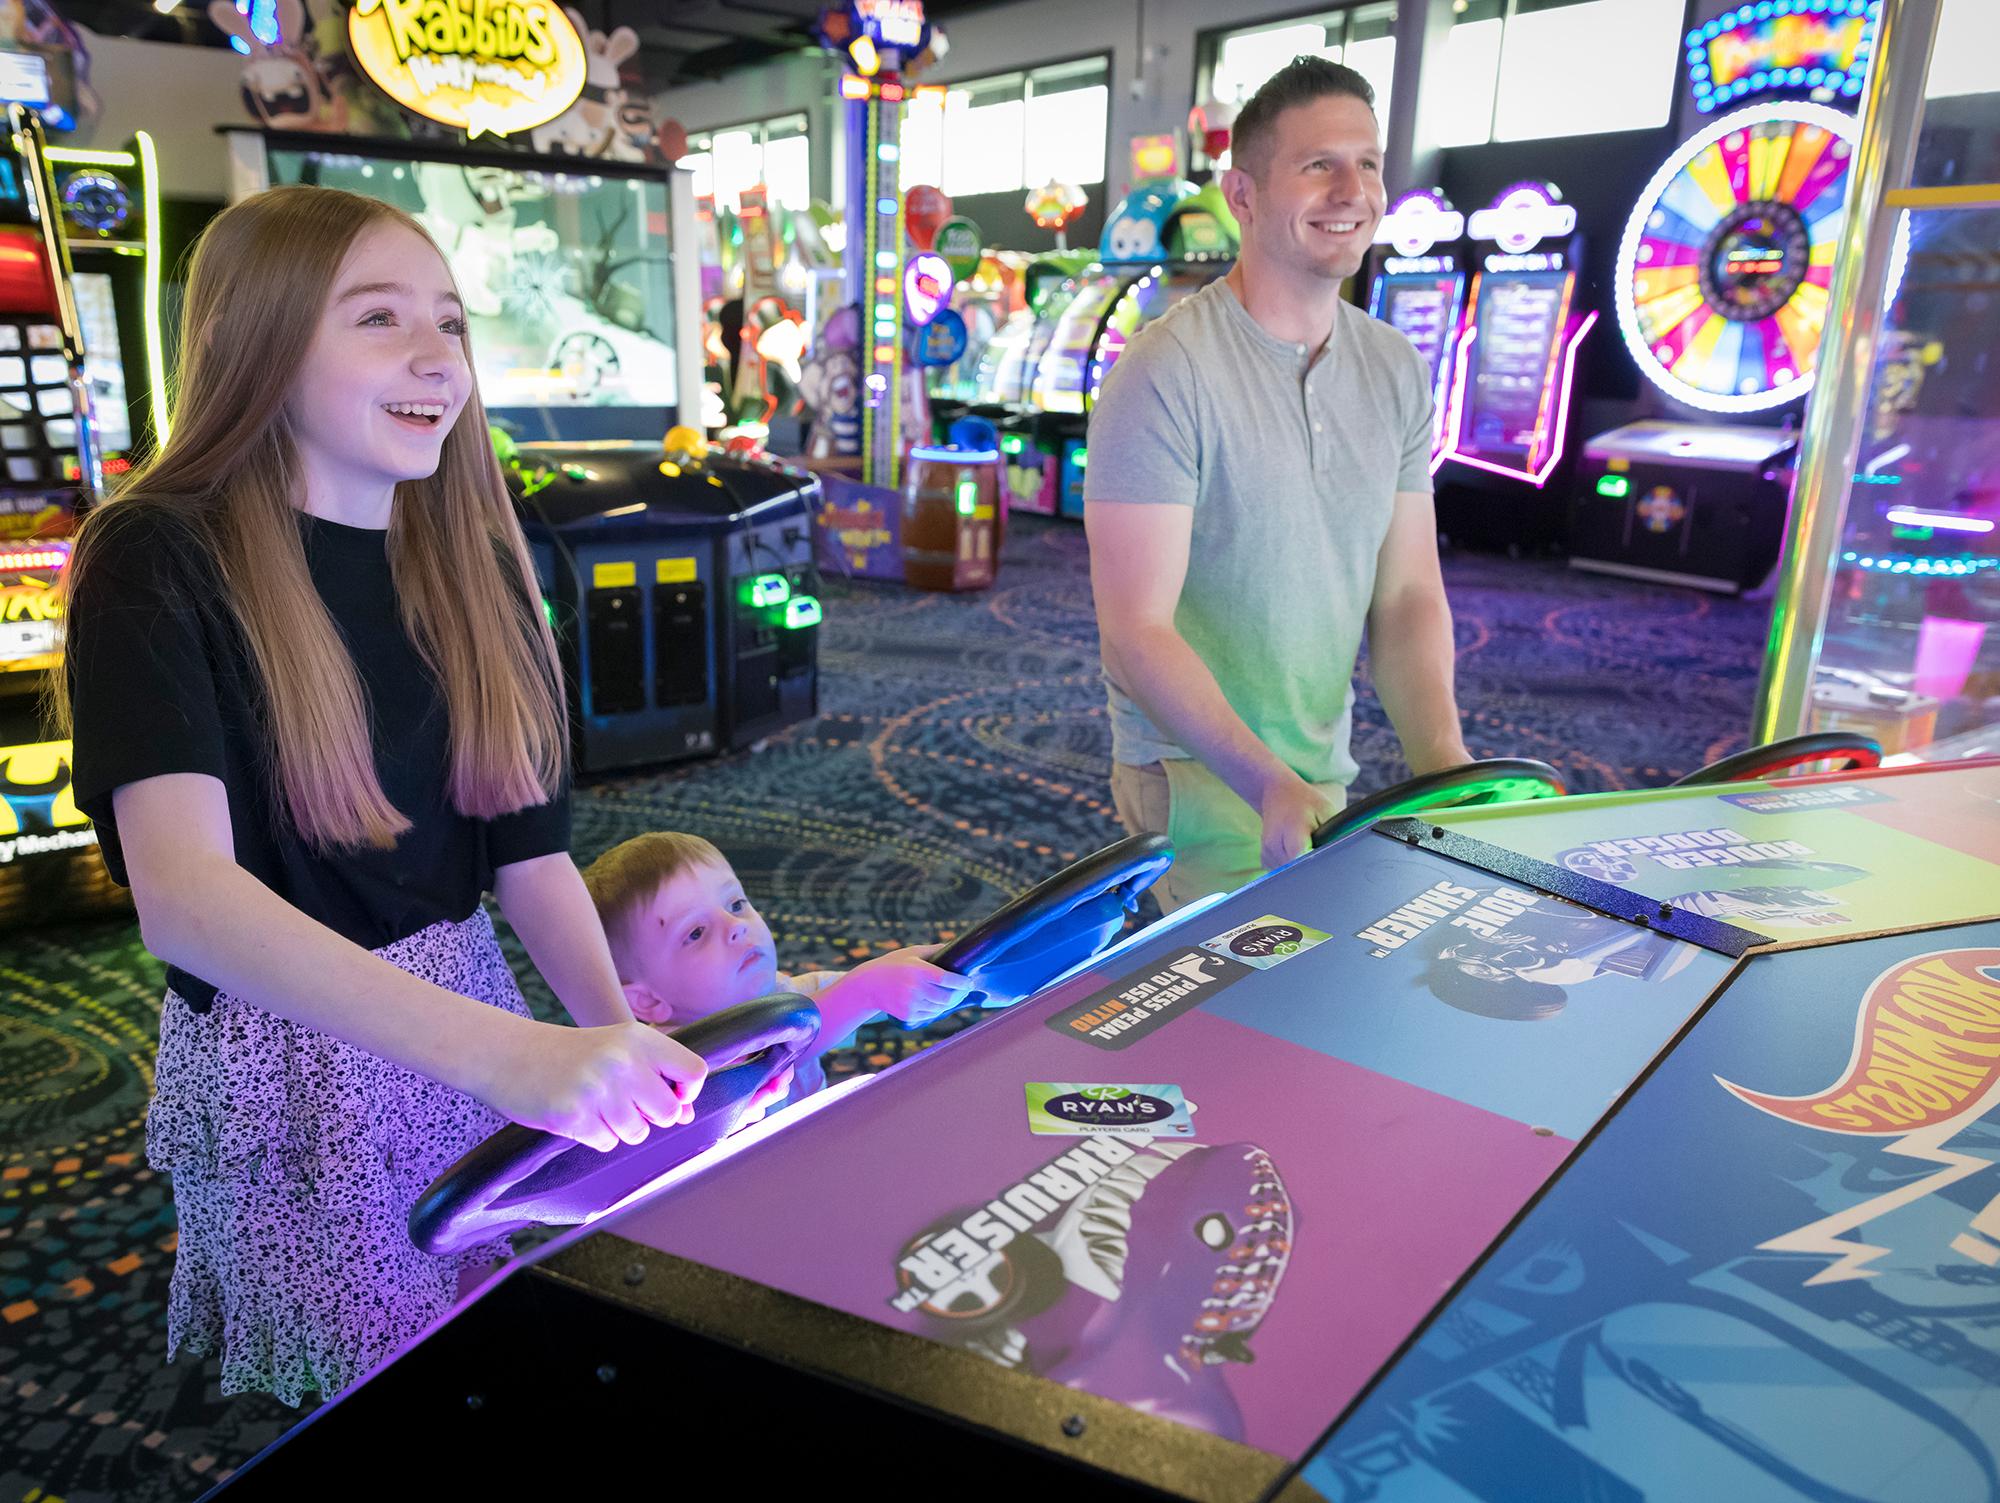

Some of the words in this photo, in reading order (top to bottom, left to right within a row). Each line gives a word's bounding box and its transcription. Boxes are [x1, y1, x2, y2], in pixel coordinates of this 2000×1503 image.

[1588, 828, 1751, 857] DODGER
[1650, 840, 1815, 870] RODGER
[1356, 881, 1478, 949] SHAKER
[1450, 887, 1540, 937] BONE
[1242, 929, 1294, 954] RYAN'S
[1119, 982, 1160, 1004] USE
[1150, 971, 1181, 987] TO
[1143, 979, 1200, 1012] PRESS
[1069, 999, 1129, 1033] NITRO
[1089, 1006, 1152, 1040] PEDAL
[1061, 1096, 1157, 1114] RYAN'S
[900, 1135, 1154, 1290] RKRUISER
